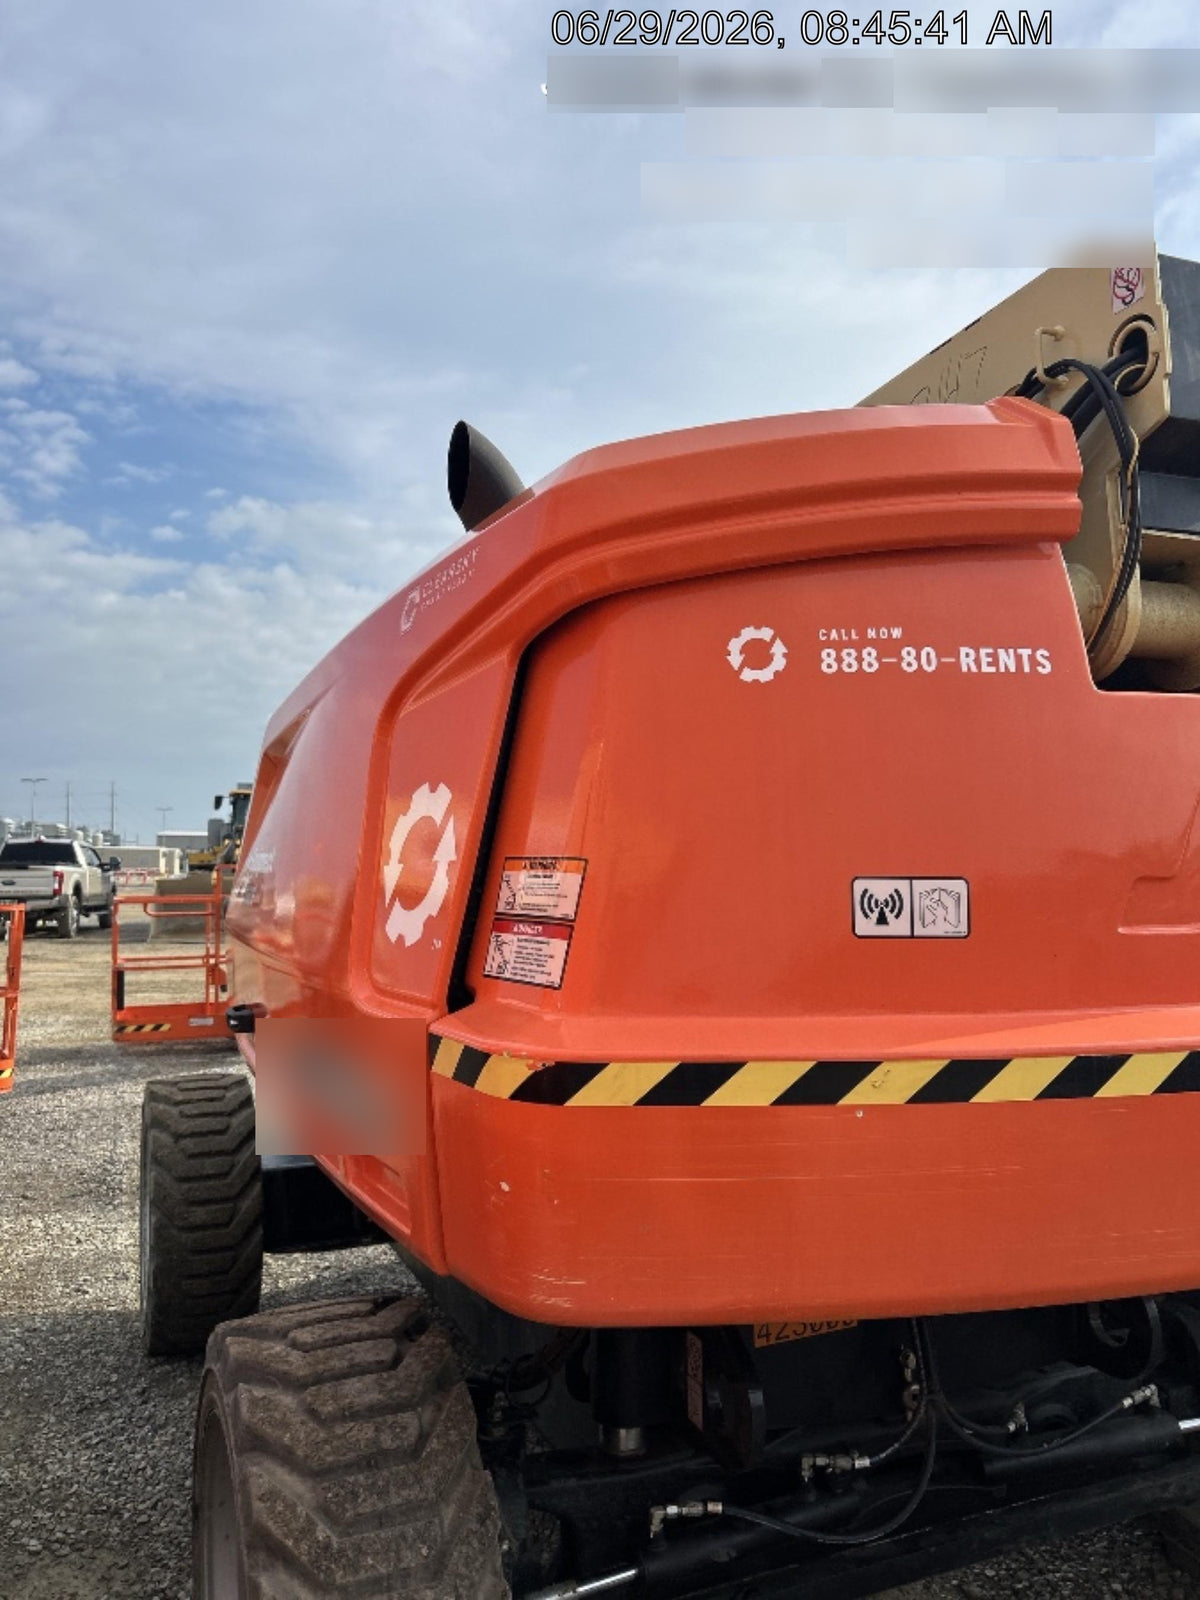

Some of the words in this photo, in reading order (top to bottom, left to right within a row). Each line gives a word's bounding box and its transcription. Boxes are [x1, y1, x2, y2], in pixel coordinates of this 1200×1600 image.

[819, 628, 859, 640] CALL
[867, 627, 903, 639] NOW
[820, 646, 1052, 674] 888-80-RENTS
